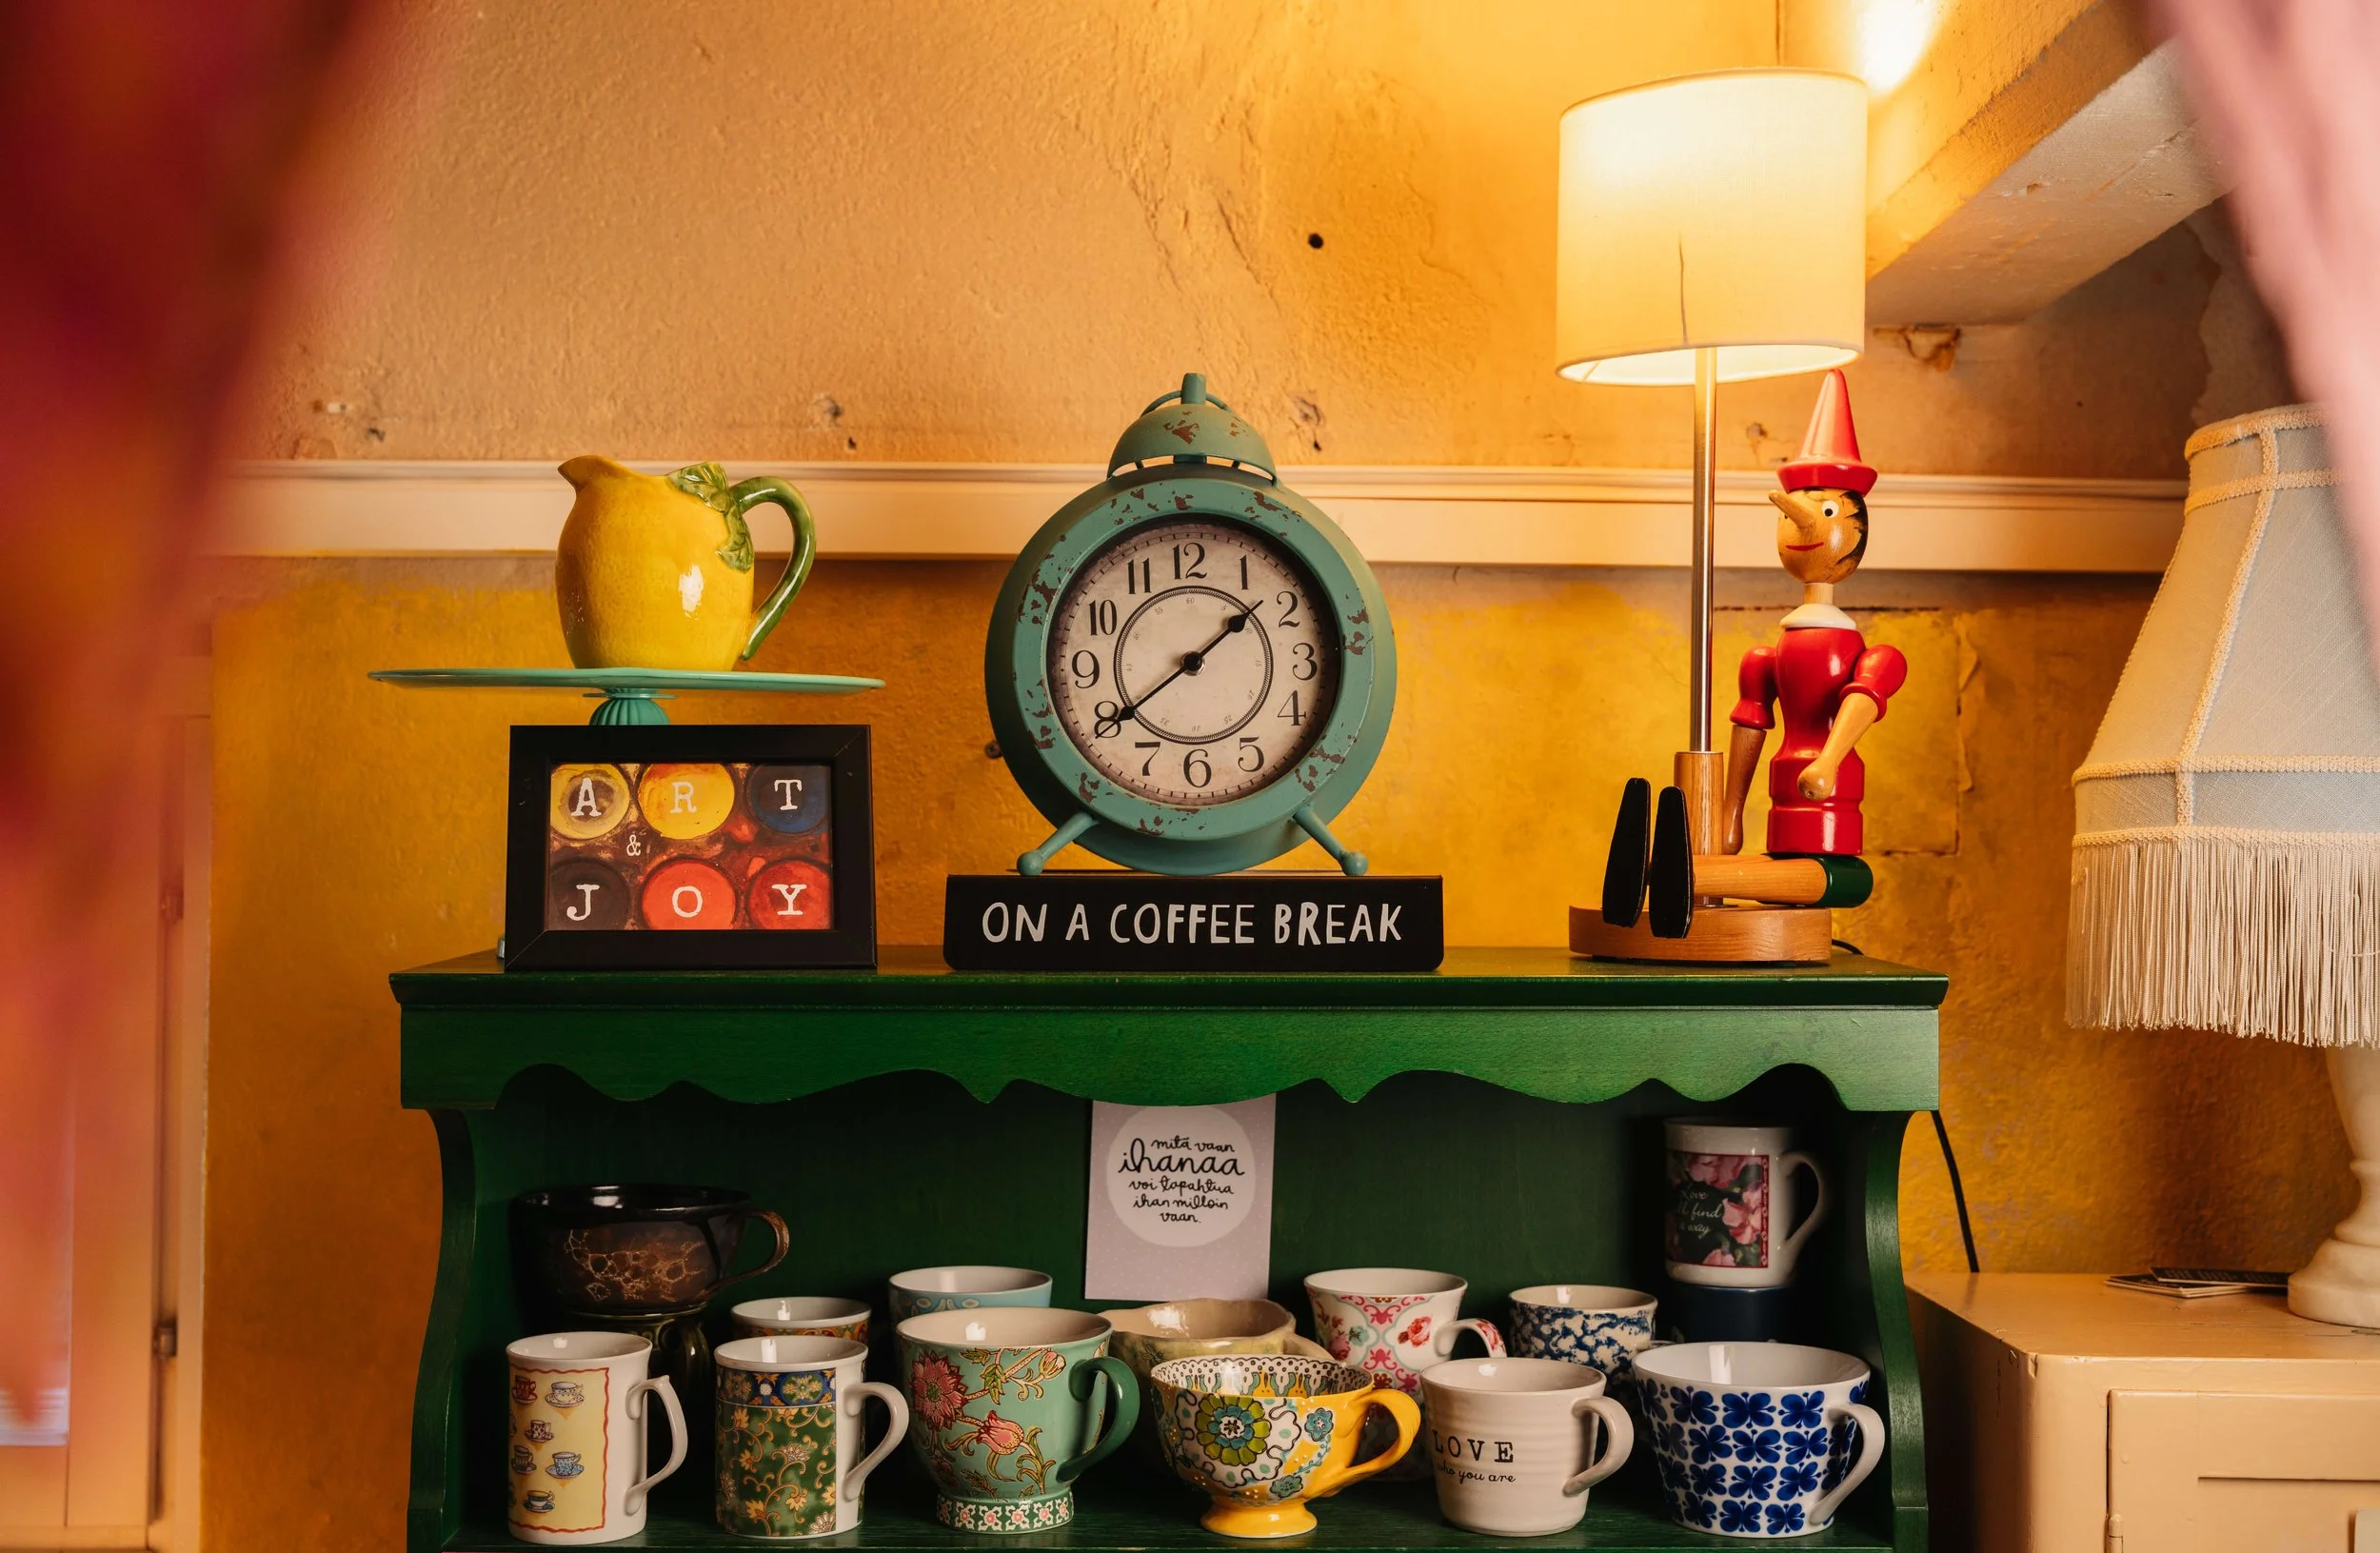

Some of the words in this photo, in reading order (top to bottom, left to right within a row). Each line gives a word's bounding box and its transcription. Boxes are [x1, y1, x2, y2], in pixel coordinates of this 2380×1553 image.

[1126, 557, 1152, 594] 11
[1172, 543, 1207, 580] 12
[1240, 554, 1250, 590] 1
[1088, 599, 1118, 636] 10
[1276, 590, 1300, 627] 2
[1071, 649, 1100, 688] 9
[1292, 642, 1319, 681] 3
[1094, 700, 1121, 739] 8
[1277, 689, 1307, 727] 4
[1134, 741, 1161, 777] 7
[1182, 748, 1212, 788] 6
[1238, 736, 1265, 772] 5
[626, 834, 641, 856] &
[982, 902, 1048, 944] ON
[1065, 903, 1090, 942] A
[1110, 902, 1256, 945] COFFEE
[1274, 902, 1402, 946] BREAK
[1118, 1138, 1245, 1176] ihanaa
[1194, 1141, 1235, 1153] vaan
[1128, 1180, 1158, 1191] voi
[1159, 1175, 1235, 1196] tapahtua
[1133, 1193, 1170, 1208] ihan
[1172, 1195, 1229, 1210] milloin
[1690, 1203, 1722, 1222] find
[1432, 1429, 1514, 1463] LOVE
[1438, 1459, 1457, 1476] who
[1458, 1469, 1485, 1484] you
[1488, 1473, 1517, 1483] are
